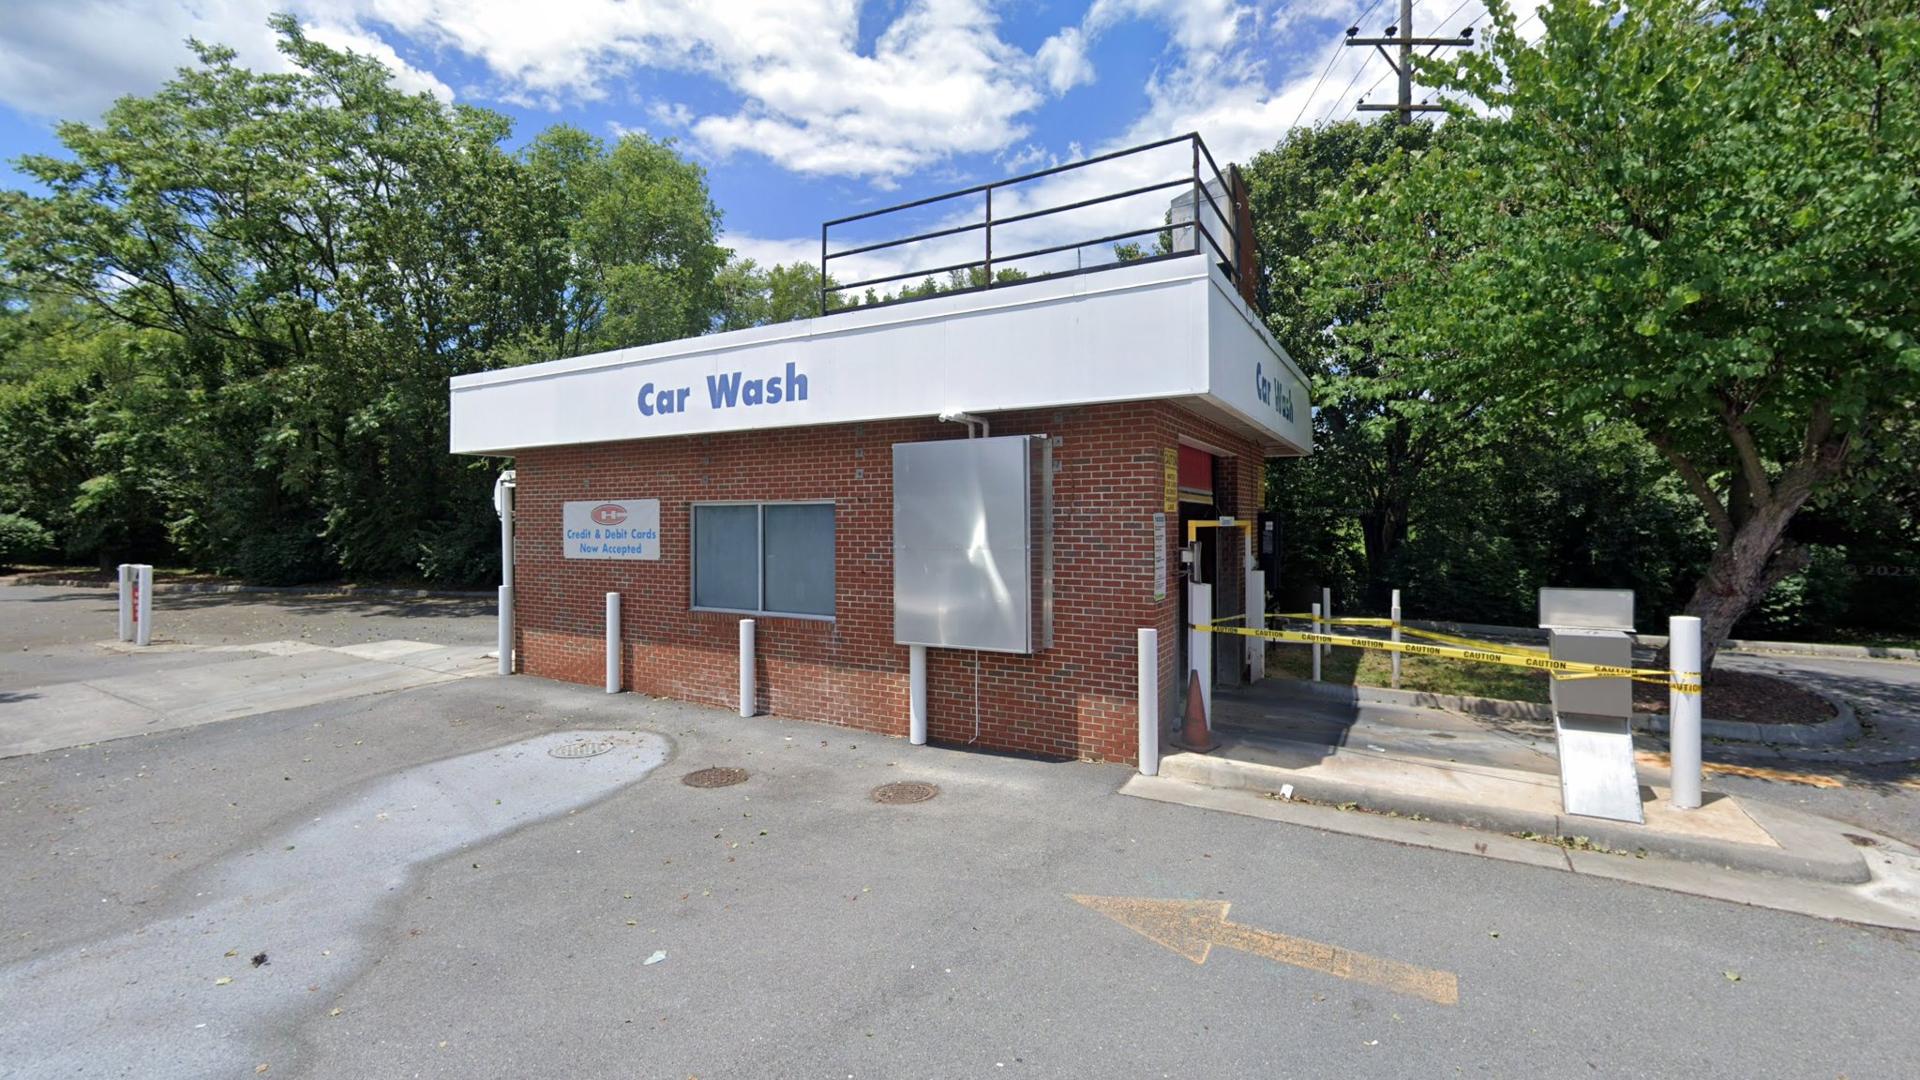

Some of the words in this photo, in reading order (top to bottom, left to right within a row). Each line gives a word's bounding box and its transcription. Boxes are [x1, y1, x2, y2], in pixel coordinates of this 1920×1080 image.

[637, 382, 690, 416] Car
[706, 362, 808, 410] Wash
[1256, 361, 1271, 407] Car
[1274, 377, 1294, 424] Wash
[567, 529, 591, 540] Credit
[594, 529, 601, 540] &
[605, 528, 628, 539] Debit
[631, 528, 657, 540] Cards
[580, 543, 599, 553] Now
[602, 542, 642, 556] Accepted
[1255, 629, 1284, 638] CAUTION
[1301, 633, 1332, 643] CAUTION
[1351, 639, 1384, 648] CAUTION
[1405, 644, 1441, 654] CAUTION
[1463, 650, 1501, 662] CAUTION
[1526, 658, 1567, 670] CAUTION
